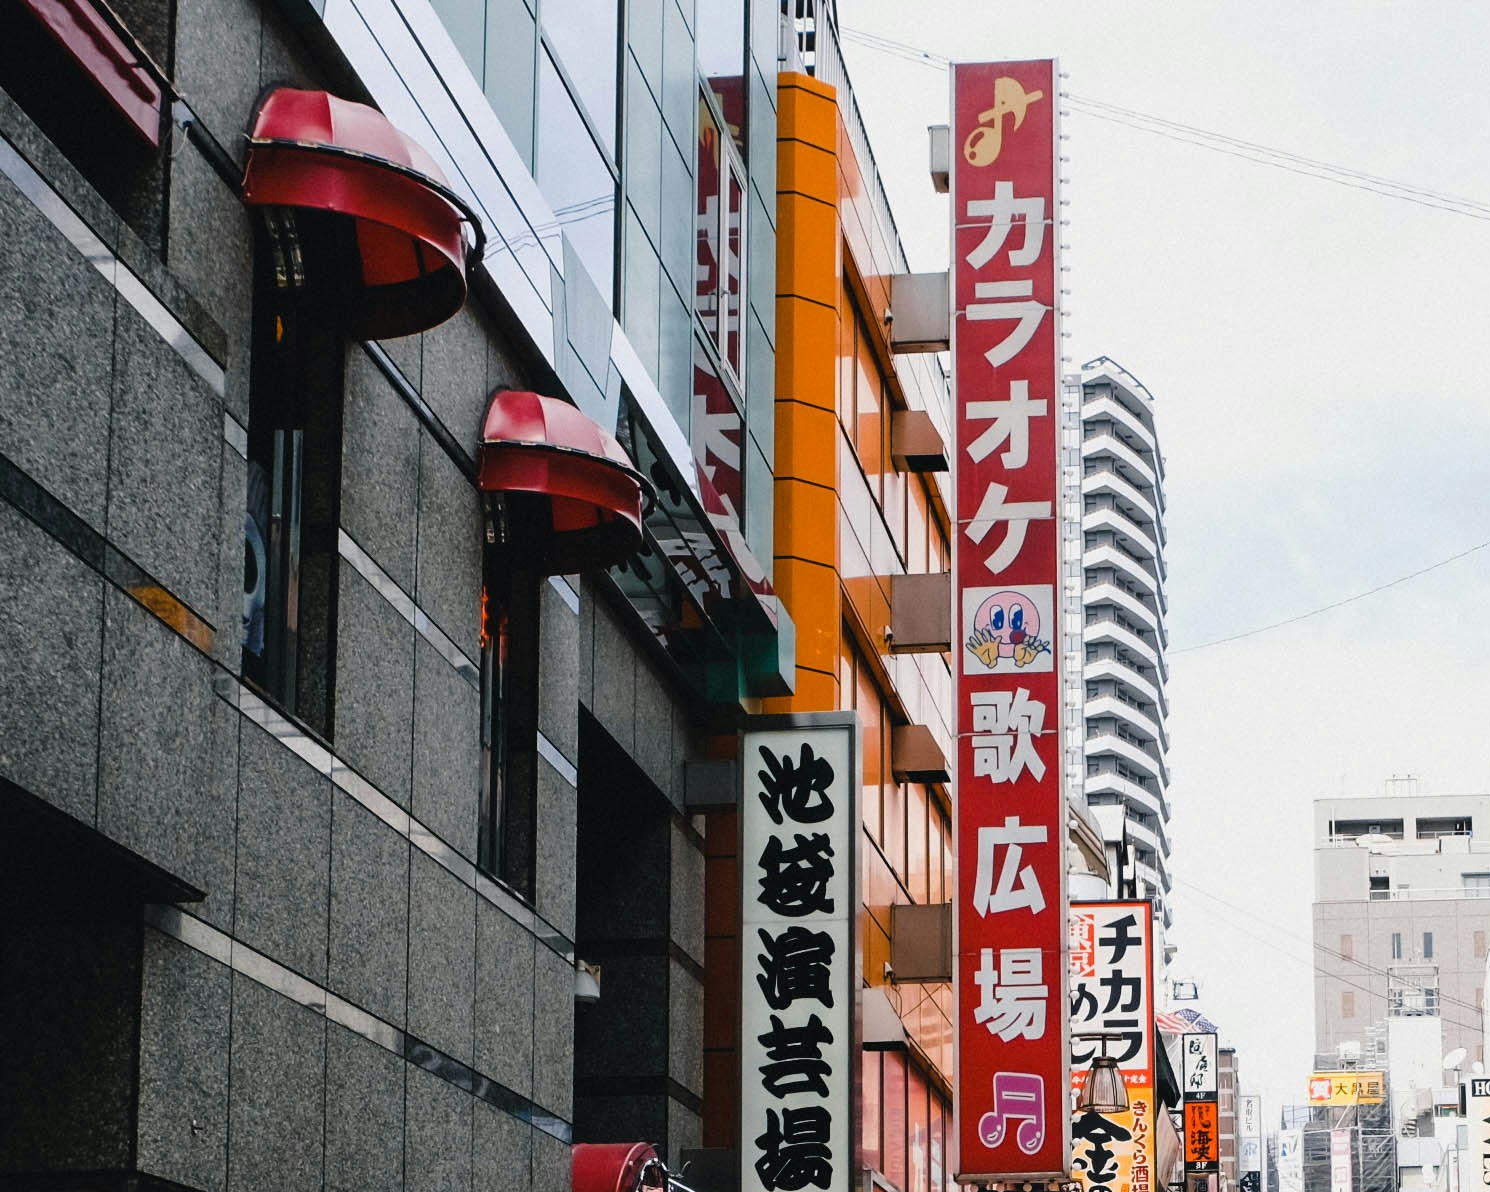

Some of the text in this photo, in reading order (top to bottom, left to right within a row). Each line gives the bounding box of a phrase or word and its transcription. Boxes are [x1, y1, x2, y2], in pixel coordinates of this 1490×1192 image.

[965, 180, 1051, 575] カラオケ
[756, 742, 836, 1192] 池袋演芸場
[970, 687, 1050, 1043] 歌広場
[1099, 914, 1142, 1063] チカラ
[1335, 1082, 1380, 1097] 大黒屋
